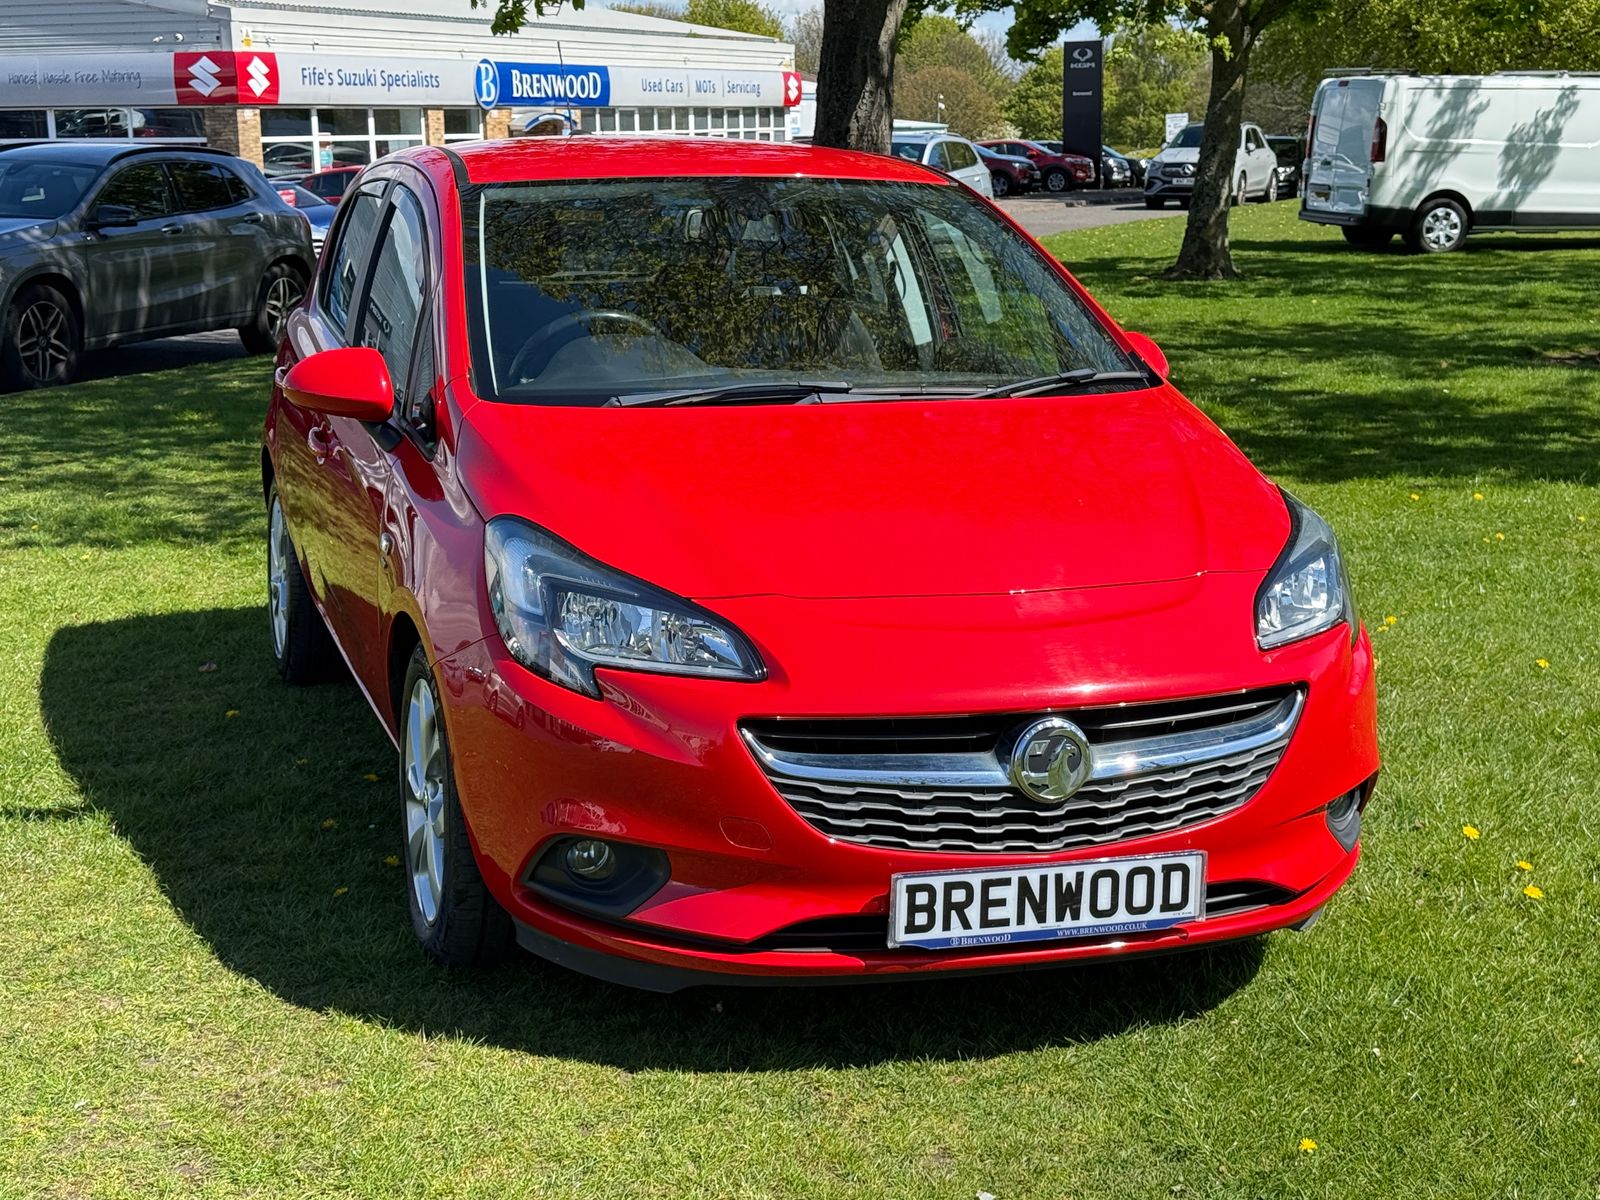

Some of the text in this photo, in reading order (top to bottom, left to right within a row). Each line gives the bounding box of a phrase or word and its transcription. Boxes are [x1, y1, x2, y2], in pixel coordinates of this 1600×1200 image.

[75, 71, 98, 83] Free
[301, 67, 440, 92] Fife's Suzuki Specialists
[479, 63, 496, 102] B
[511, 69, 601, 99] BRENWOOD
[641, 78, 683, 93] Used Cars
[695, 80, 716, 93] MOTs
[727, 80, 761, 97] Servicing
[904, 862, 1191, 934] BRENWOOD
[1056, 921, 1148, 937] WWW.BRENWOOD.CO.UK
[961, 933, 1011, 945] BRENWOOD
